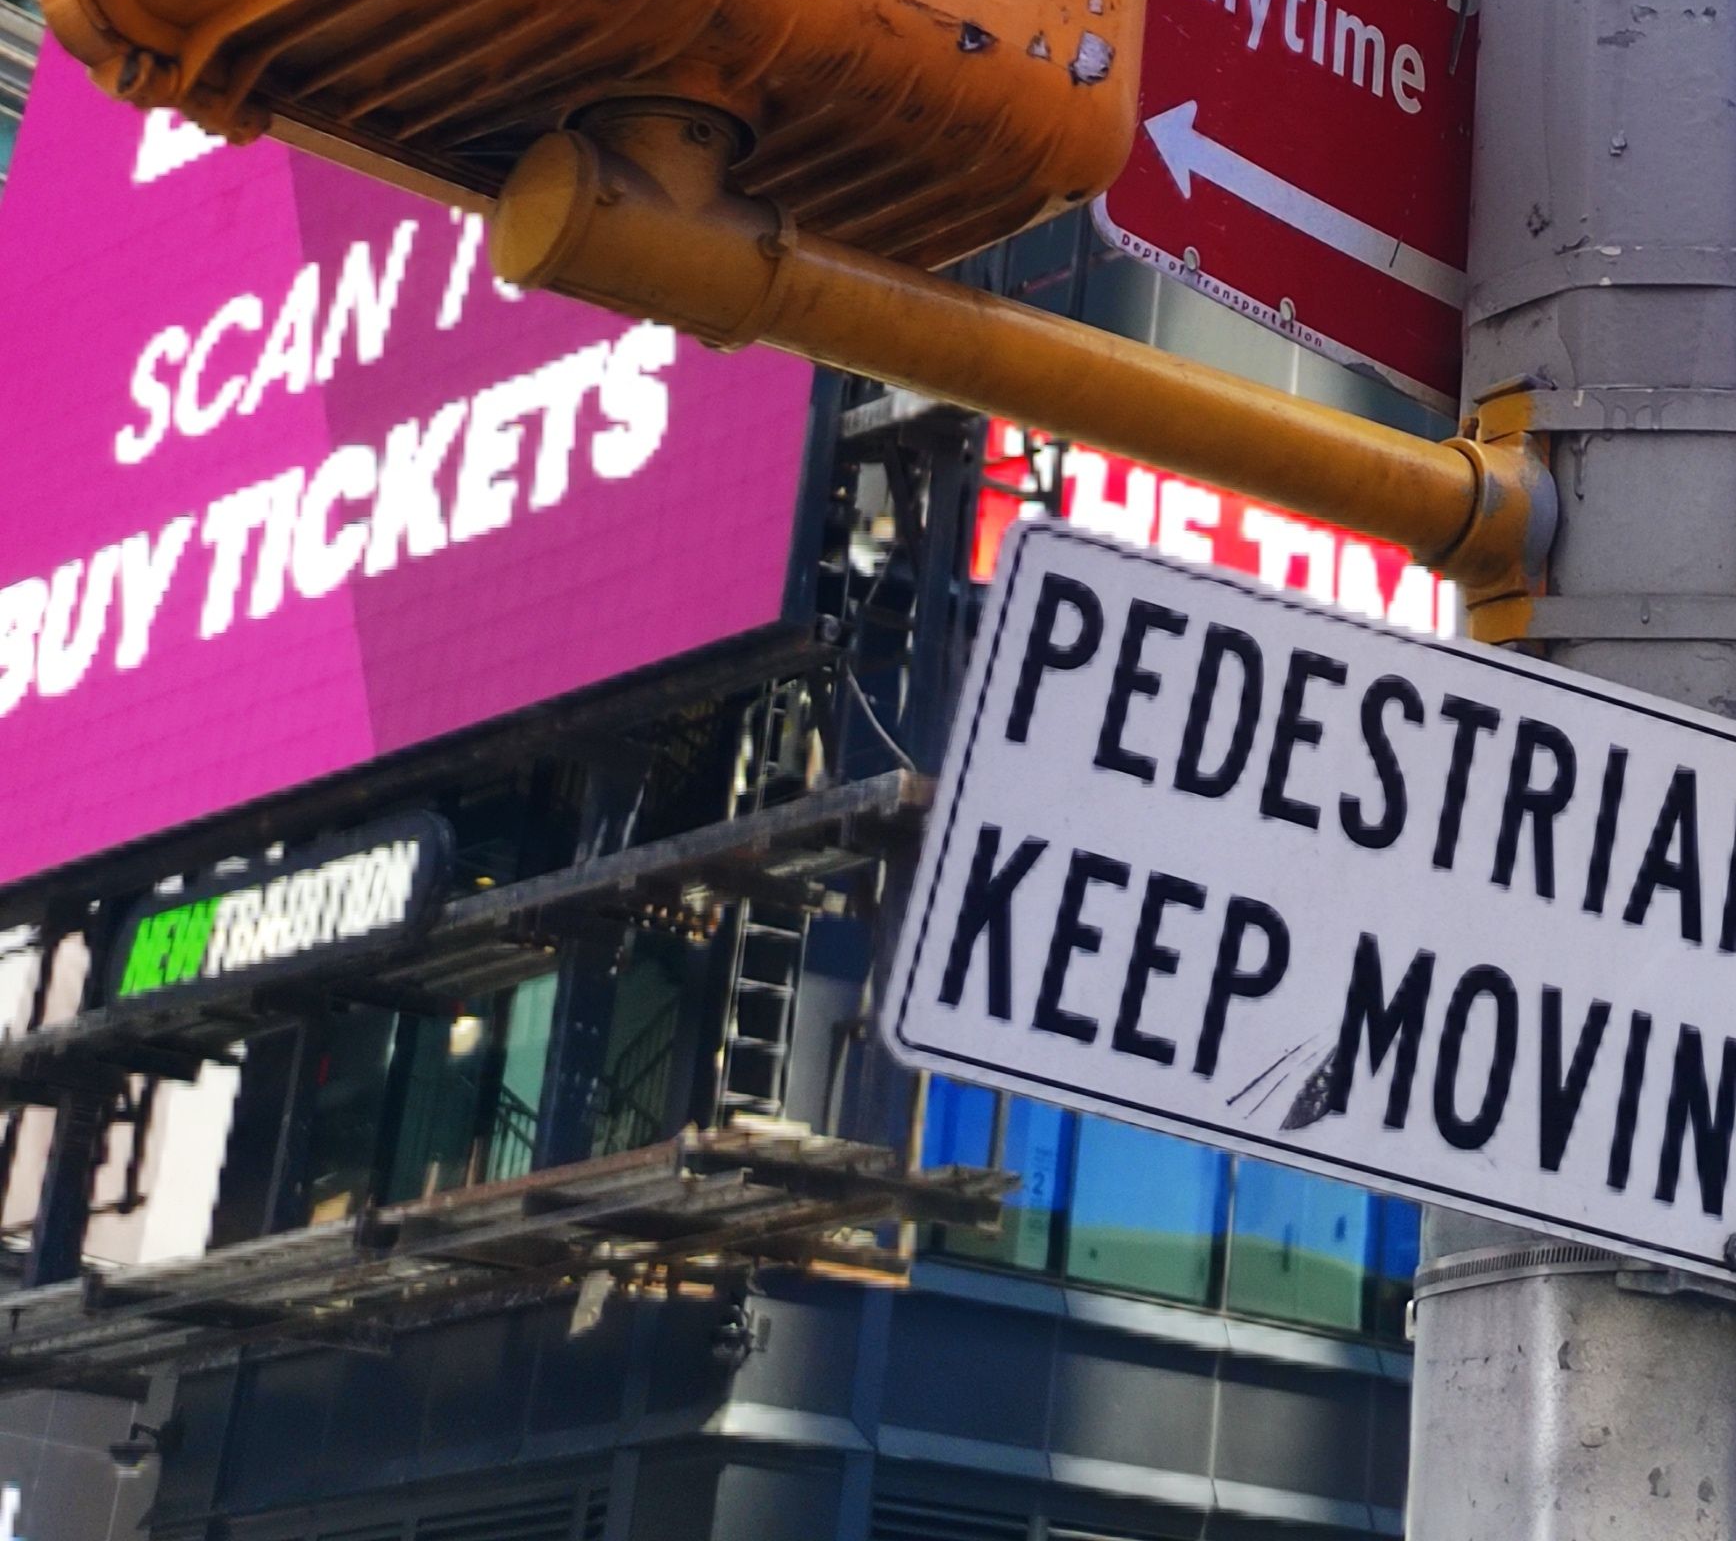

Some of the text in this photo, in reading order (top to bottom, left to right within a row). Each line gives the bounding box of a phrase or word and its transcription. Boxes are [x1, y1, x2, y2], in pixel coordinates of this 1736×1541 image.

[115, 220, 417, 463] SCAN
[1121, 233, 1324, 349] Dept of Transportation
[0, 321, 677, 716] BUY TICKETS
[938, 821, 1291, 1079] KEEP
